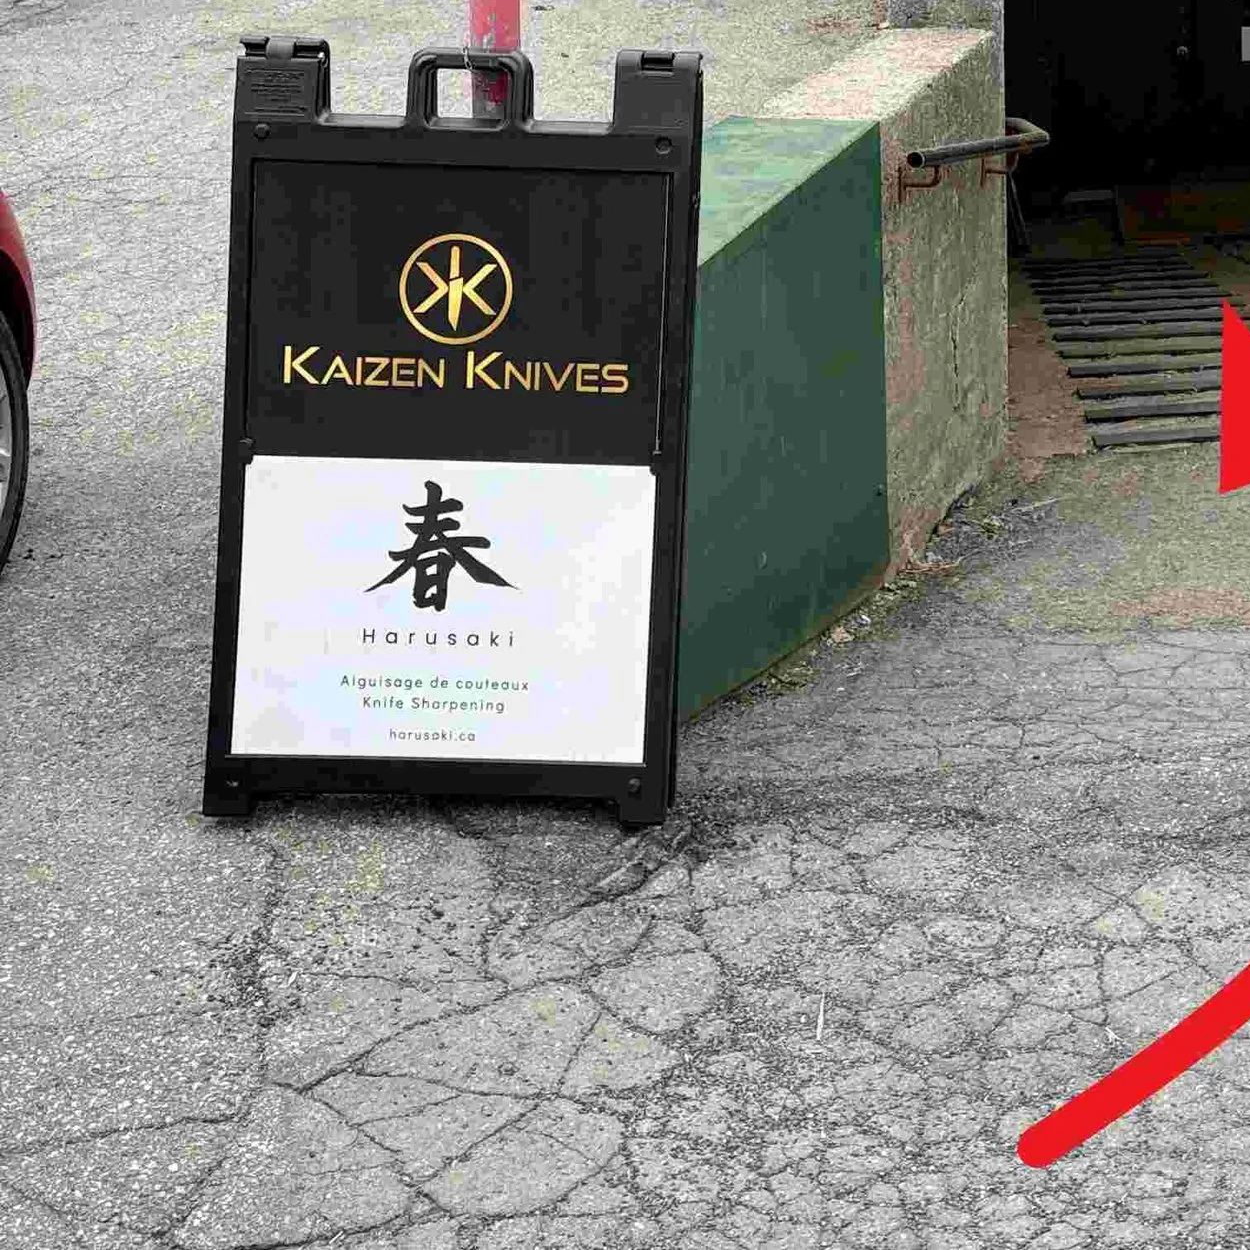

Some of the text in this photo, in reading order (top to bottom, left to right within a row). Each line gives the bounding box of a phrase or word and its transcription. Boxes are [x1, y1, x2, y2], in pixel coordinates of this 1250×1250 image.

[363, 480, 521, 612] 春
[362, 628, 514, 648] Harusaki
[340, 674, 529, 691] Aiguisage de couteaux
[363, 696, 505, 714] Knife Sharpening
[389, 728, 476, 742] harusaki.ca
